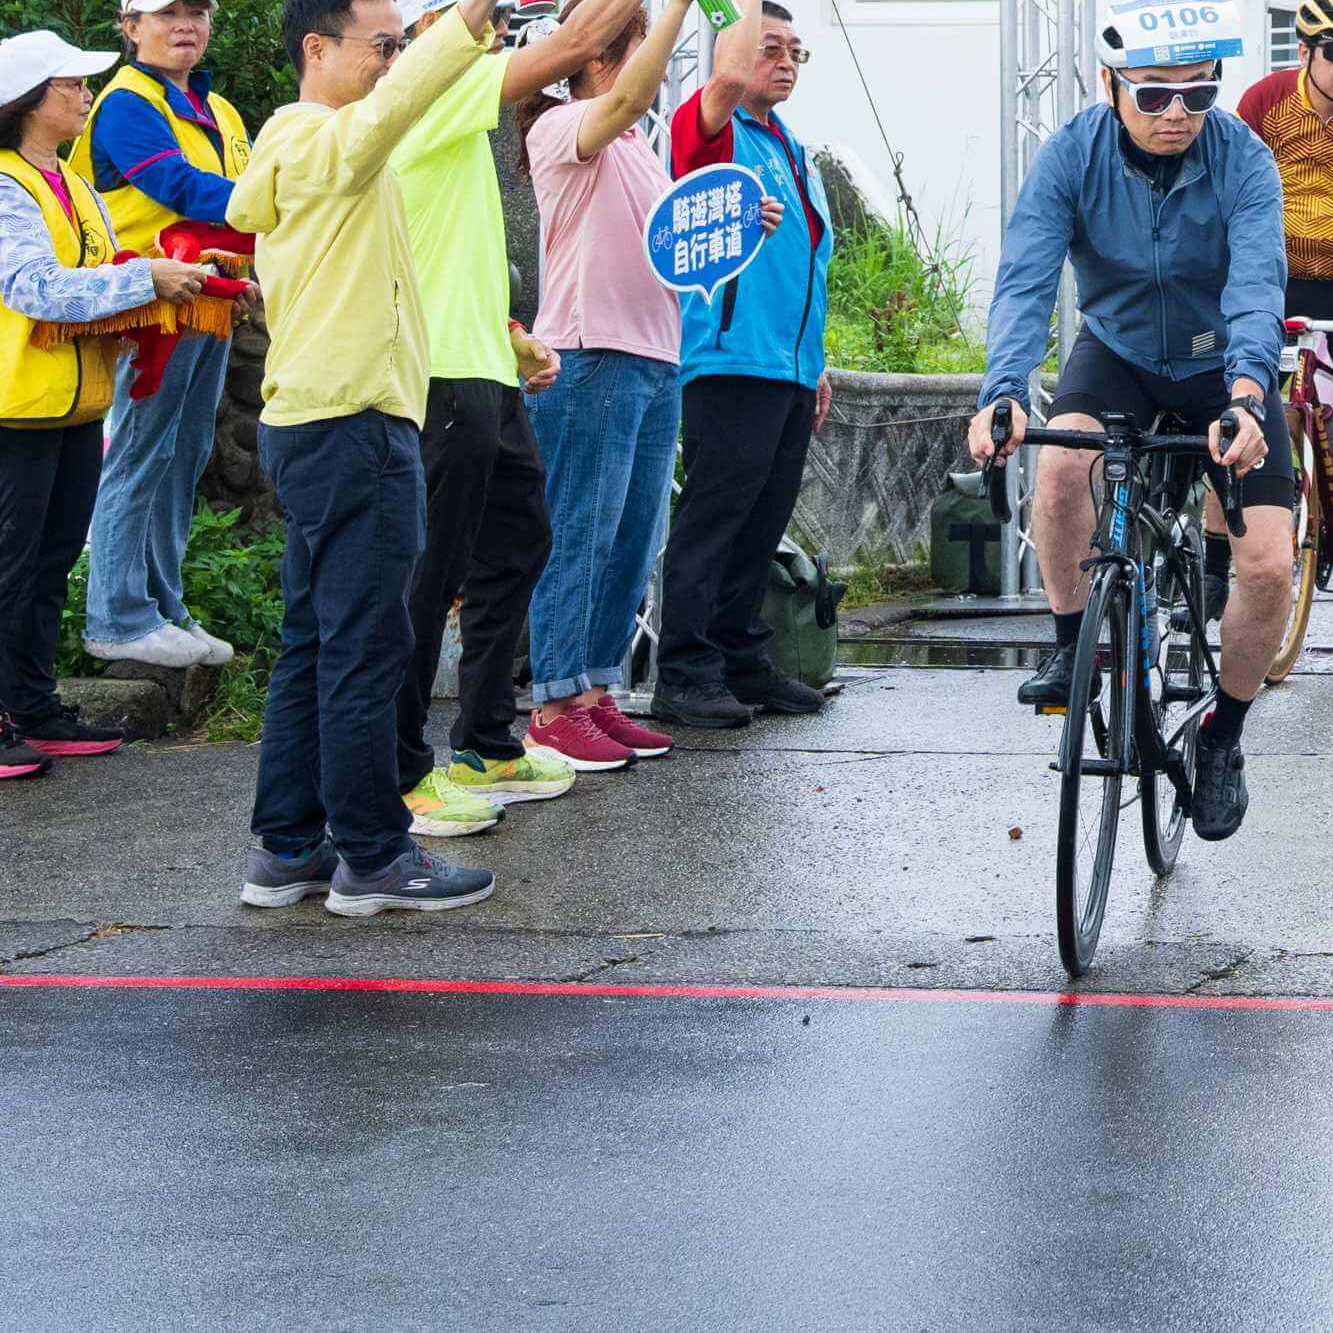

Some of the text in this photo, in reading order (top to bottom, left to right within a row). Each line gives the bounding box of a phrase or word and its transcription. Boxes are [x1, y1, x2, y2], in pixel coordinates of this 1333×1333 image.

[1138, 5, 1220, 31] 0106
[672, 222, 743, 276] 自行車道
